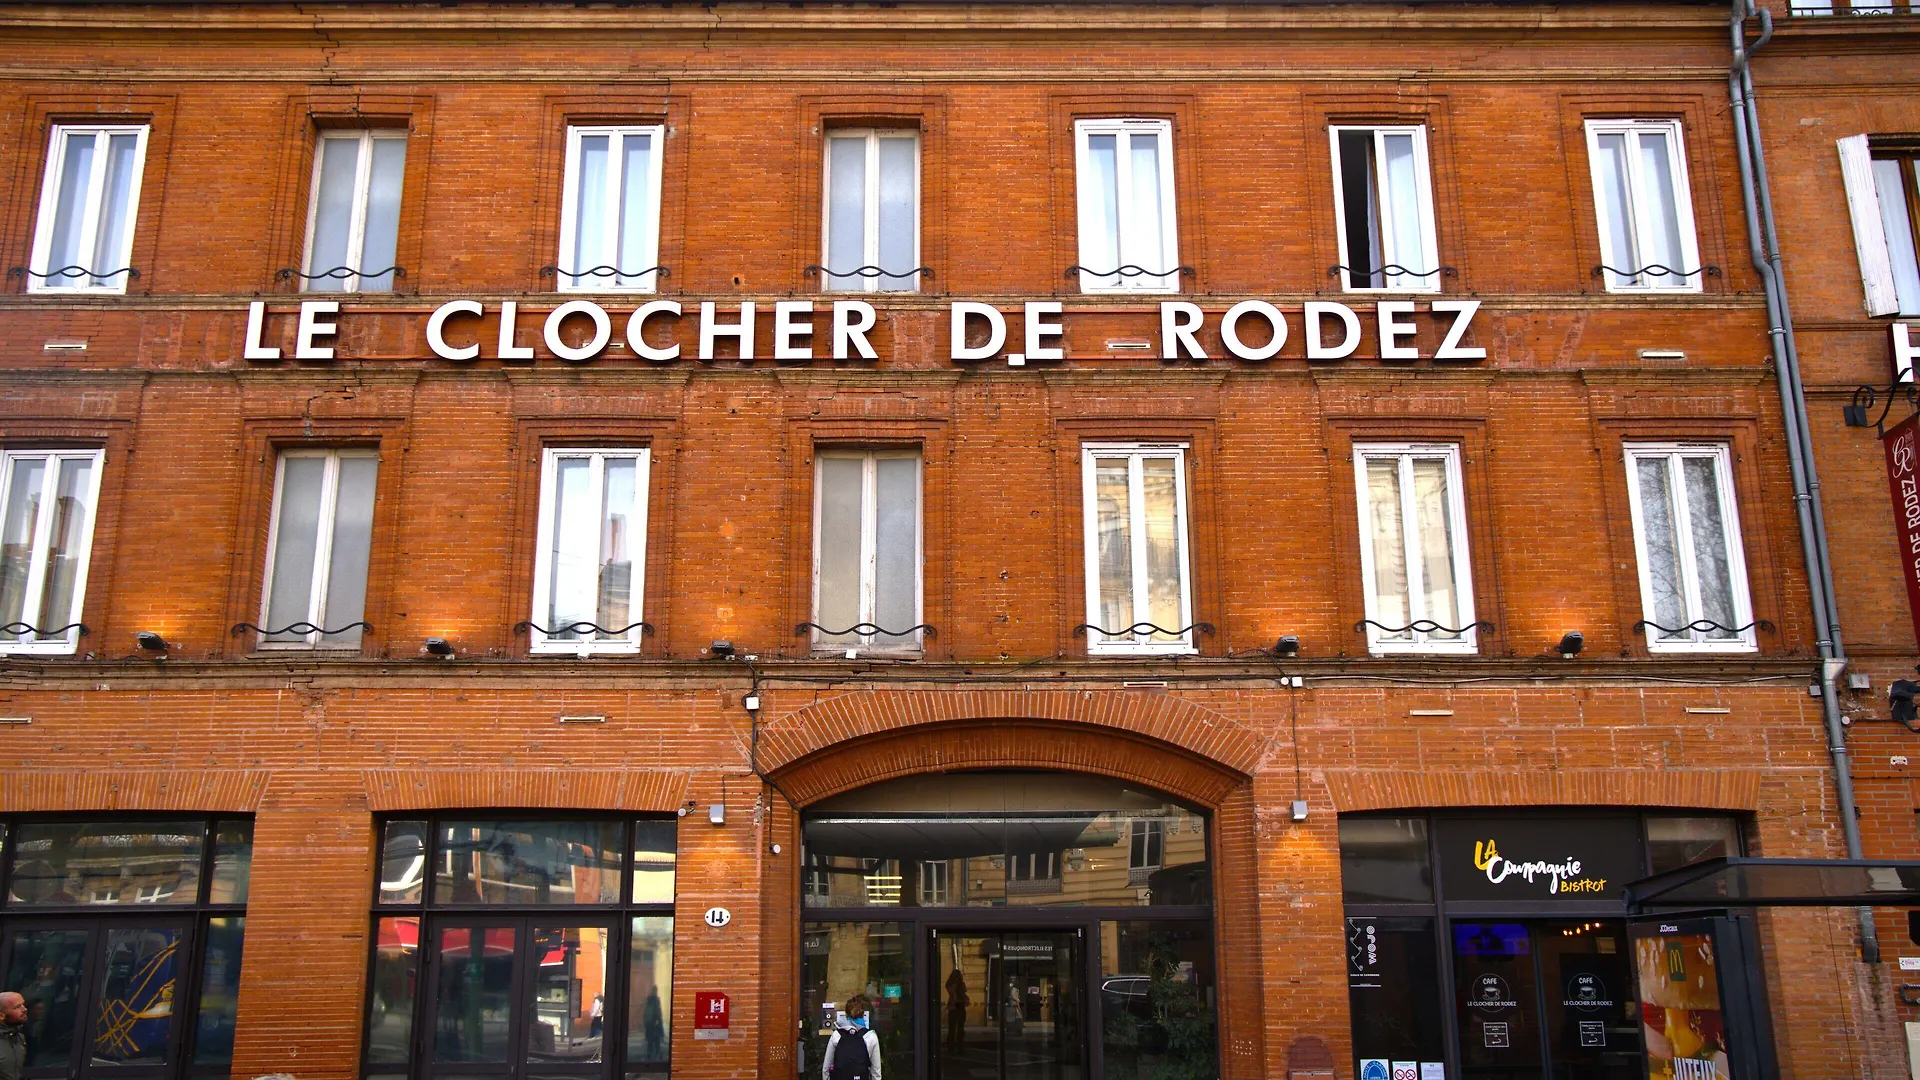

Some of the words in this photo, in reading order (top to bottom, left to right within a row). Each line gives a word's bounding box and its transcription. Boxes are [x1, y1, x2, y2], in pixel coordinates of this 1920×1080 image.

[243, 301, 340, 360] LE
[425, 300, 880, 361] CLOCHER
[950, 301, 1063, 360] DE
[1160, 300, 1487, 360] RODEZ
[1901, 474, 1920, 529] RODEZ
[1474, 839, 1499, 870] LA
[1486, 856, 1581, 894] Compagnie
